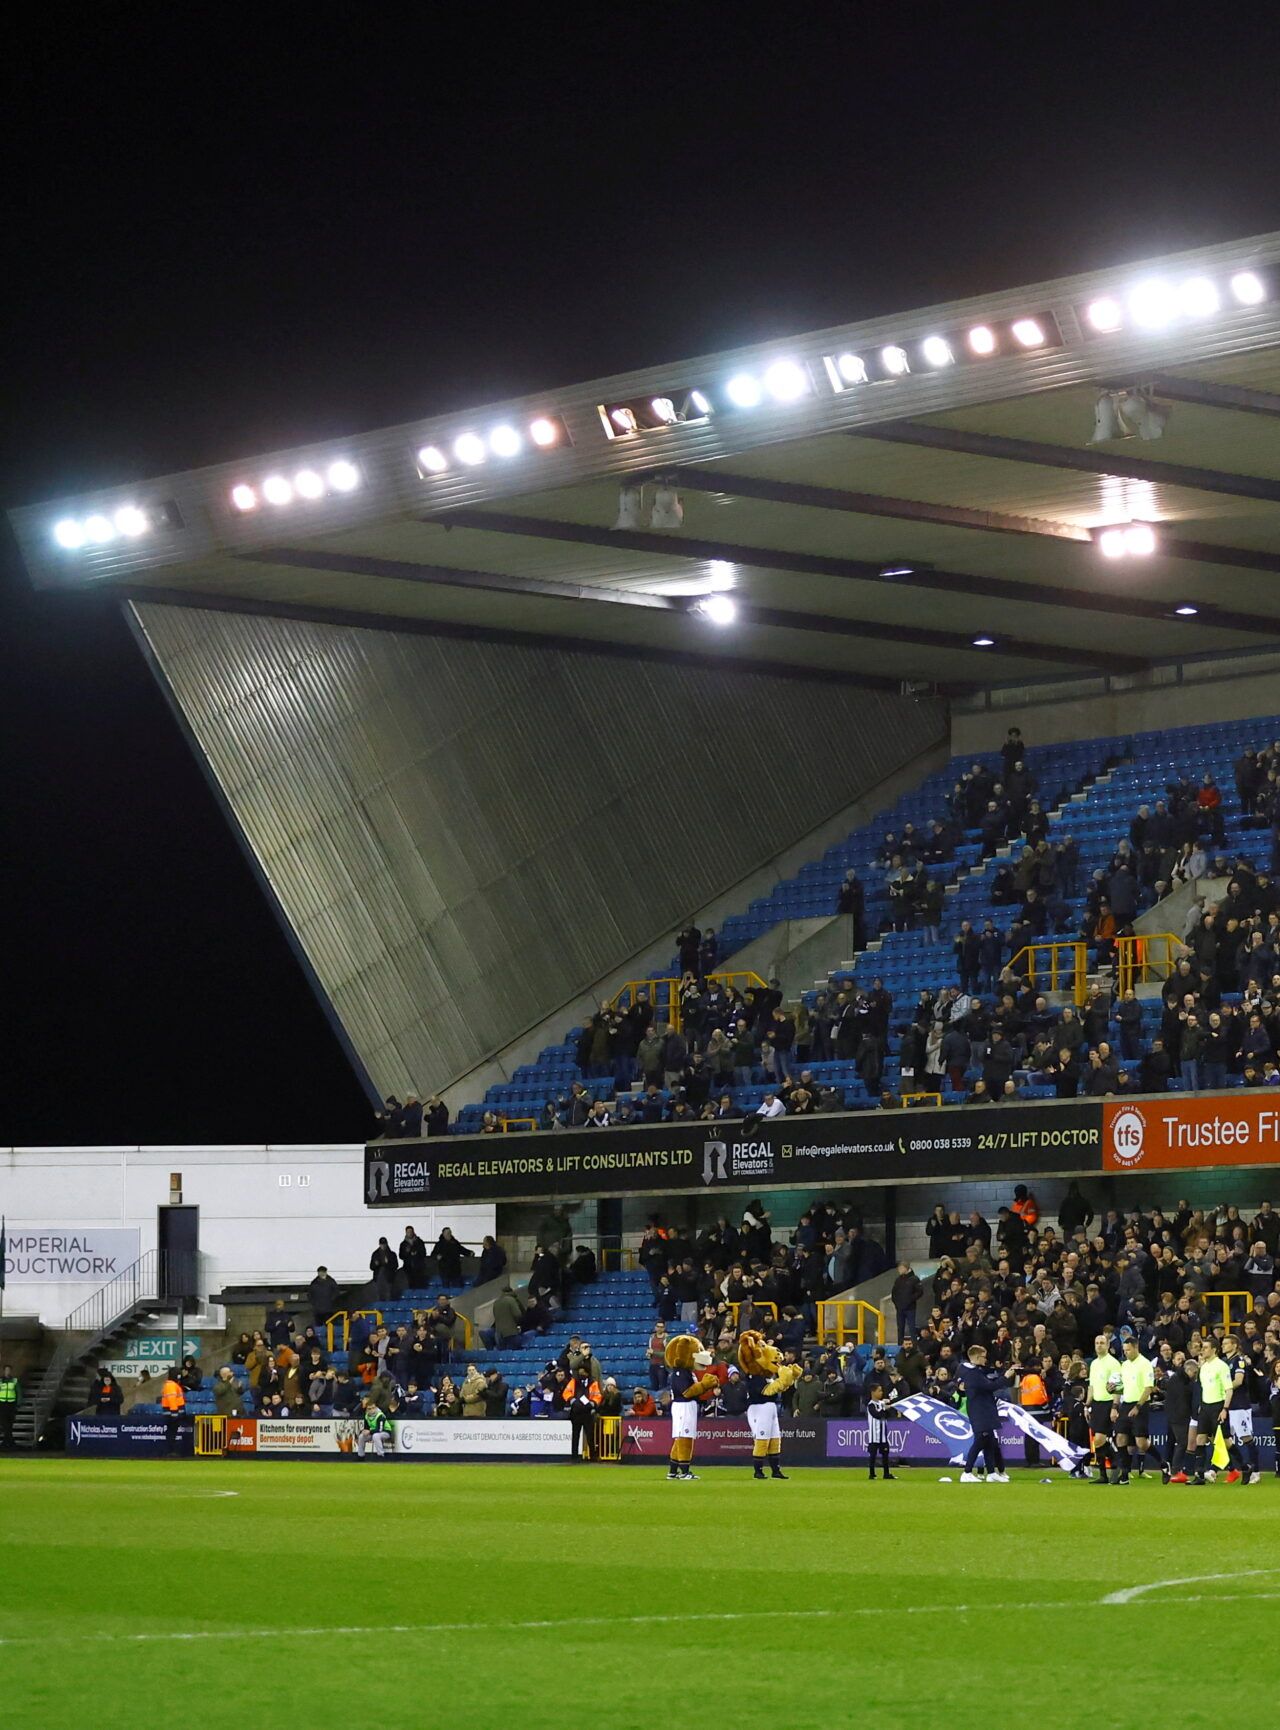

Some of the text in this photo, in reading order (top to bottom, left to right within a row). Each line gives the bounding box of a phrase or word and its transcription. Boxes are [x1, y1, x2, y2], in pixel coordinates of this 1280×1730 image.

[1117, 1124, 1141, 1147] tfs
[1162, 1116, 1250, 1148] Trustee
[909, 1136, 972, 1151] 0800 038 5339
[977, 1128, 1099, 1150] 24/7 LIFT DOCTOR
[732, 1142, 775, 1159] REGAL
[795, 1142, 895, 1158] info@regalelevators.co.uk
[393, 1162, 431, 1178] REGAL
[438, 1149, 693, 1178] REGAL ELEVATORS & LIFT CONSULTANTS LTD
[732, 1159, 769, 1170] Elevators
[393, 1177, 425, 1188] Elevators
[139, 1341, 178, 1355] EXIT
[111, 1364, 160, 1374] FIRST AID
[101, 1425, 118, 1434] James
[259, 1423, 331, 1434] Kitchens for everyone at
[712, 1429, 726, 1440] your
[726, 1428, 754, 1438] business
[795, 1427, 816, 1438] future
[259, 1434, 314, 1444] Bermondsey depot
[453, 1433, 481, 1441] SPECIALIST
[481, 1433, 511, 1441] DEMOLITION
[516, 1433, 542, 1441] ASBESTOS
[1000, 1435, 1024, 1445] Football
